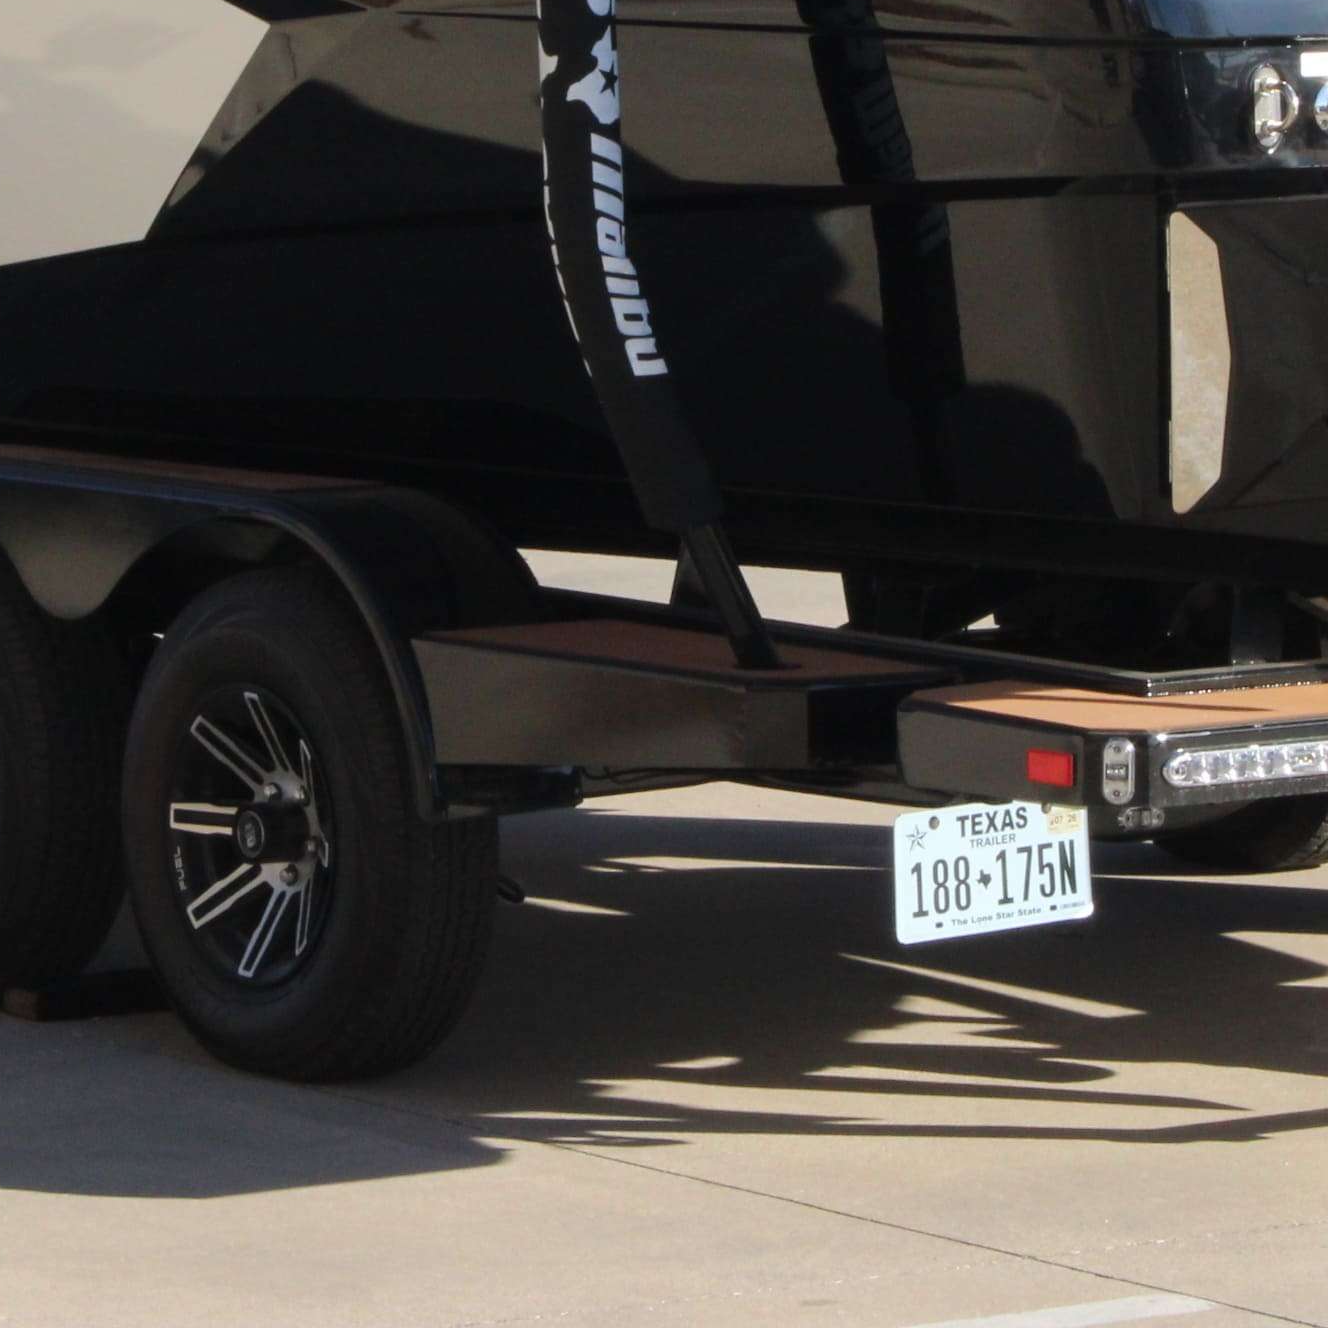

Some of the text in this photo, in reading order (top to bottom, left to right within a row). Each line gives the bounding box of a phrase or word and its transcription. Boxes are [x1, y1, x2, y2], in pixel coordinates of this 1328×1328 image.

[590, 132, 669, 377] Malibu
[956, 806, 1028, 837] TEXAS
[970, 833, 1017, 848] TRAILER
[951, 907, 1042, 927] The Lone Star State
